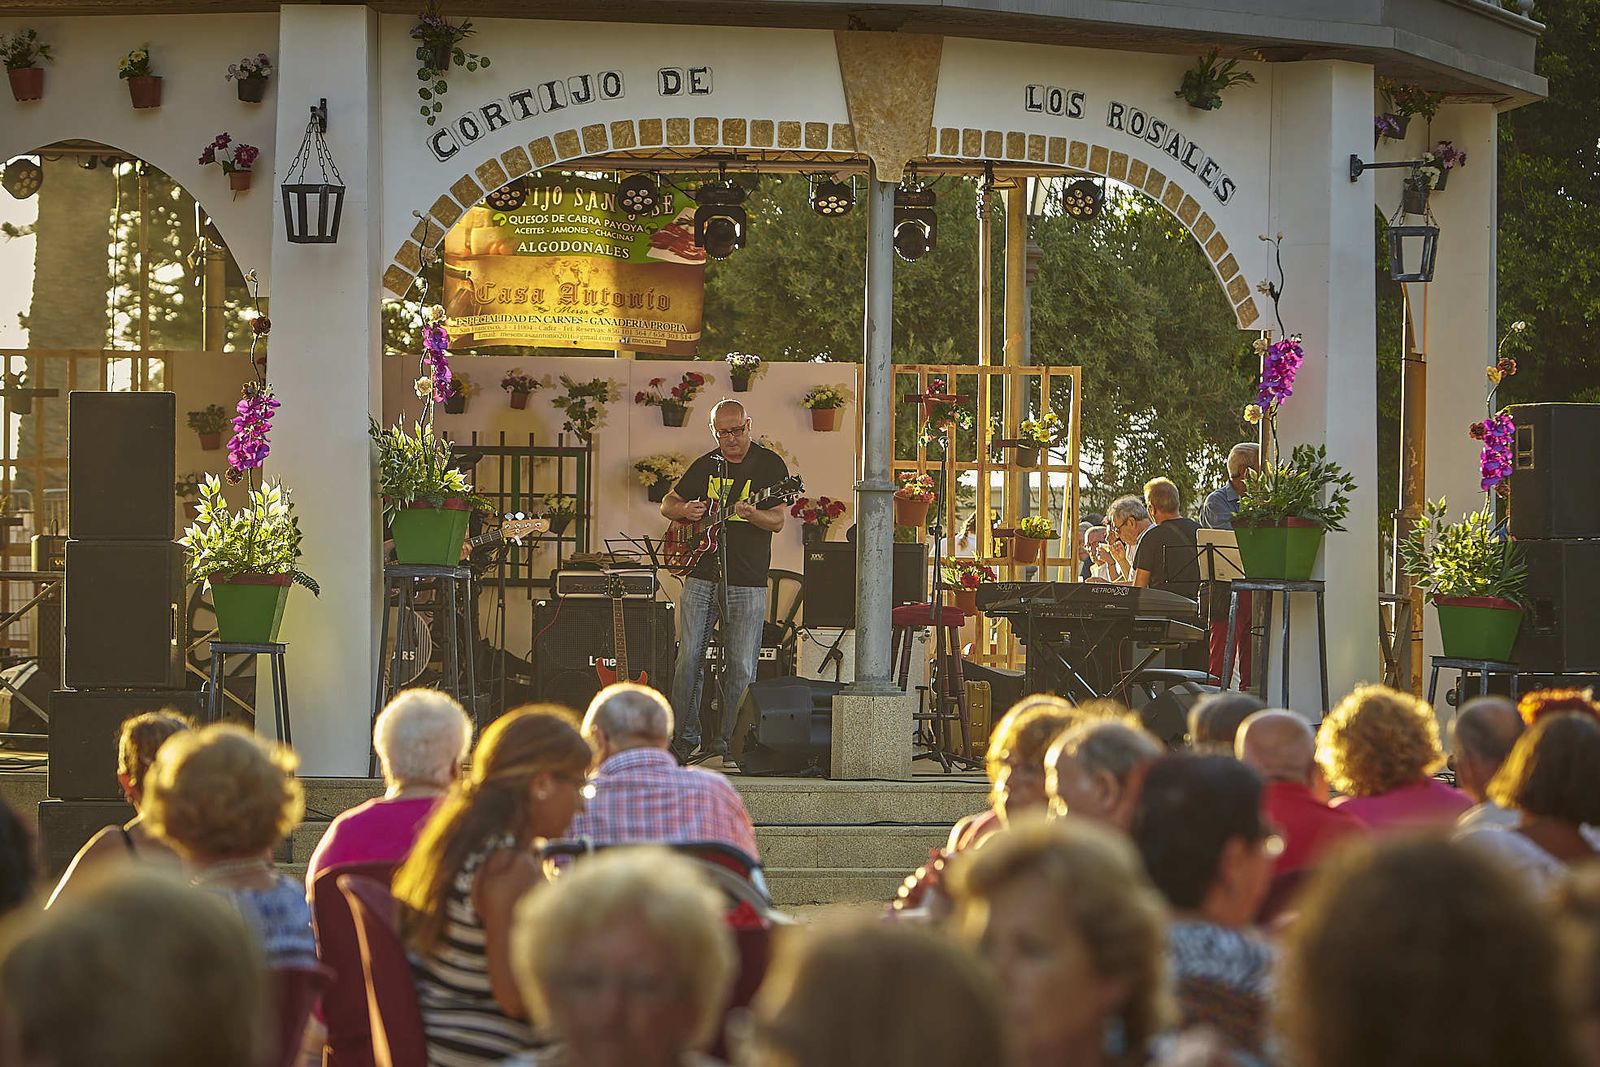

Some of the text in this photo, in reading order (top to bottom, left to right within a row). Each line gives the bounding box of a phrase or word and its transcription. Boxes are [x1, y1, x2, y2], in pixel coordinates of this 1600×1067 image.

[430, 67, 1236, 203] CORTIJO DE LOS ROSALES
[574, 187, 615, 212] SAN
[508, 214, 644, 233] QUESOS DE CABRA PAYOYA
[514, 227, 545, 235] ACEITES
[551, 226, 589, 234] JAMONES
[594, 229, 634, 242] CHACINAS
[517, 241, 630, 259] ALGODONALES
[474, 281, 671, 312] Casa Antonio
[456, 314, 526, 326] ESPECIALIDAD
[528, 315, 541, 323] EN
[543, 315, 583, 324] CARNES
[650, 321, 687, 333] PROPIA
[588, 655, 617, 667] Lne
